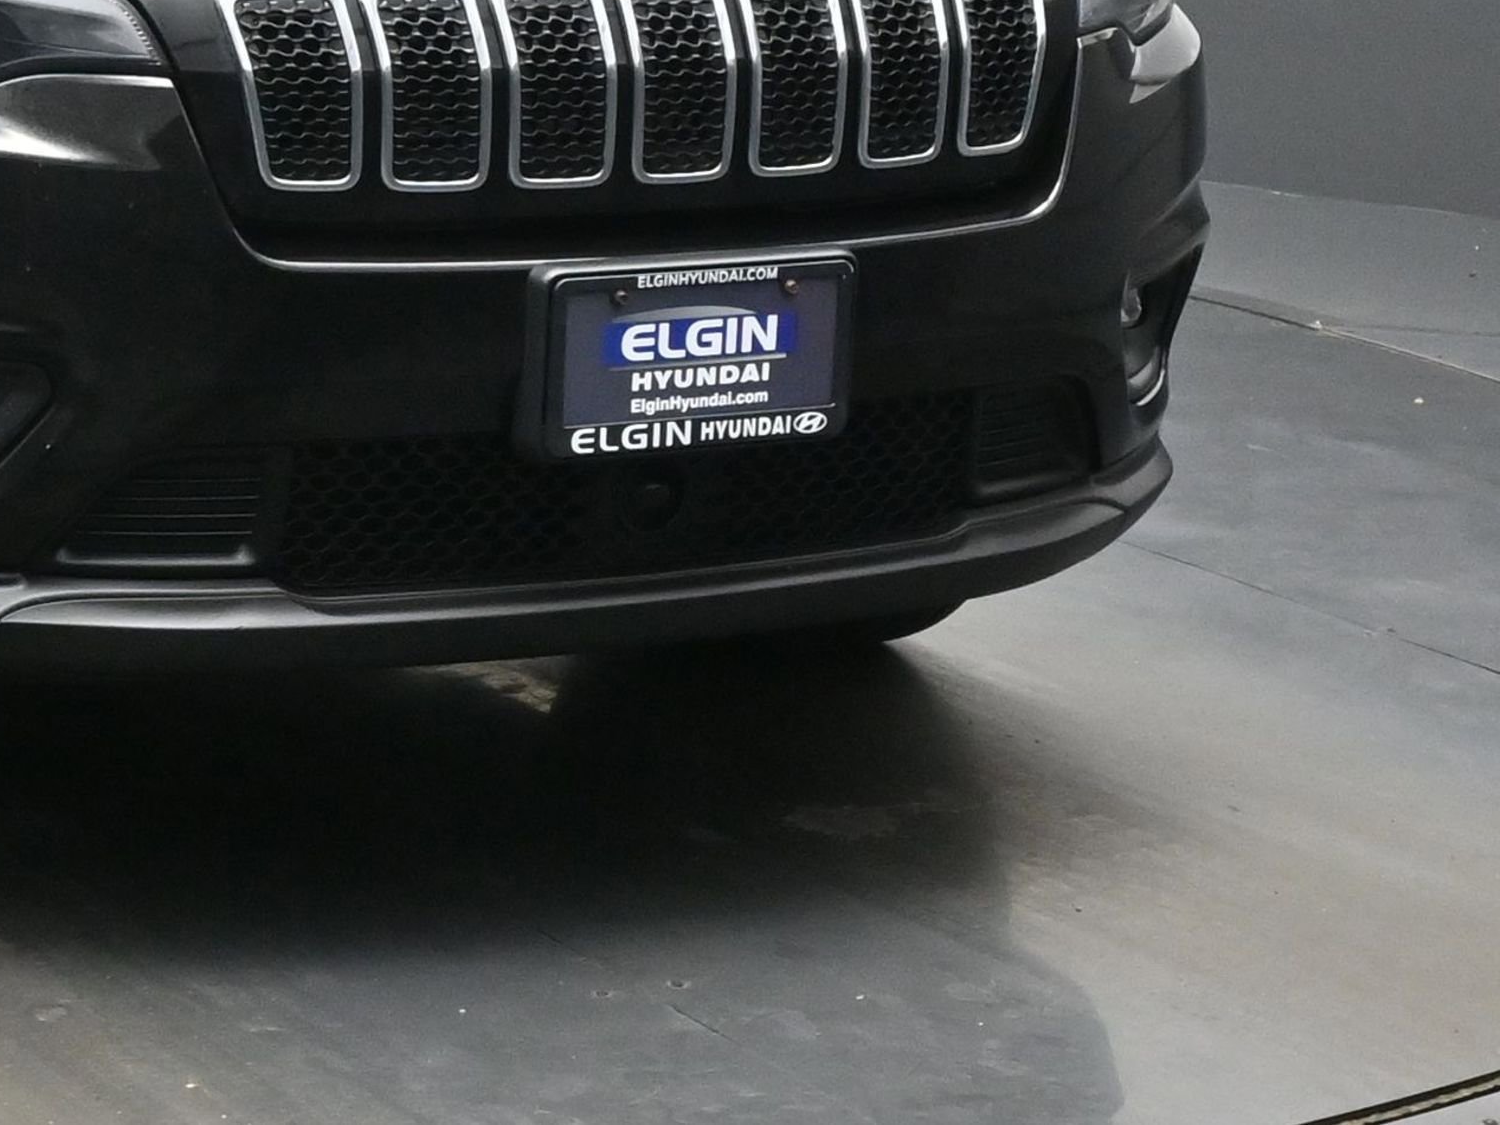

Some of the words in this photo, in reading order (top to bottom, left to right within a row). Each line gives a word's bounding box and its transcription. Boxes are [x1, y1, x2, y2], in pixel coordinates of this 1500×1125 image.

[637, 267, 779, 289] ELGINHYUNDAI.COM
[620, 314, 778, 362] ELGIN
[631, 362, 770, 392] HYUNDAI
[630, 391, 769, 415] ElginHyundai.com
[570, 420, 692, 455] ELGIN
[700, 415, 791, 441] HYUNDAI
